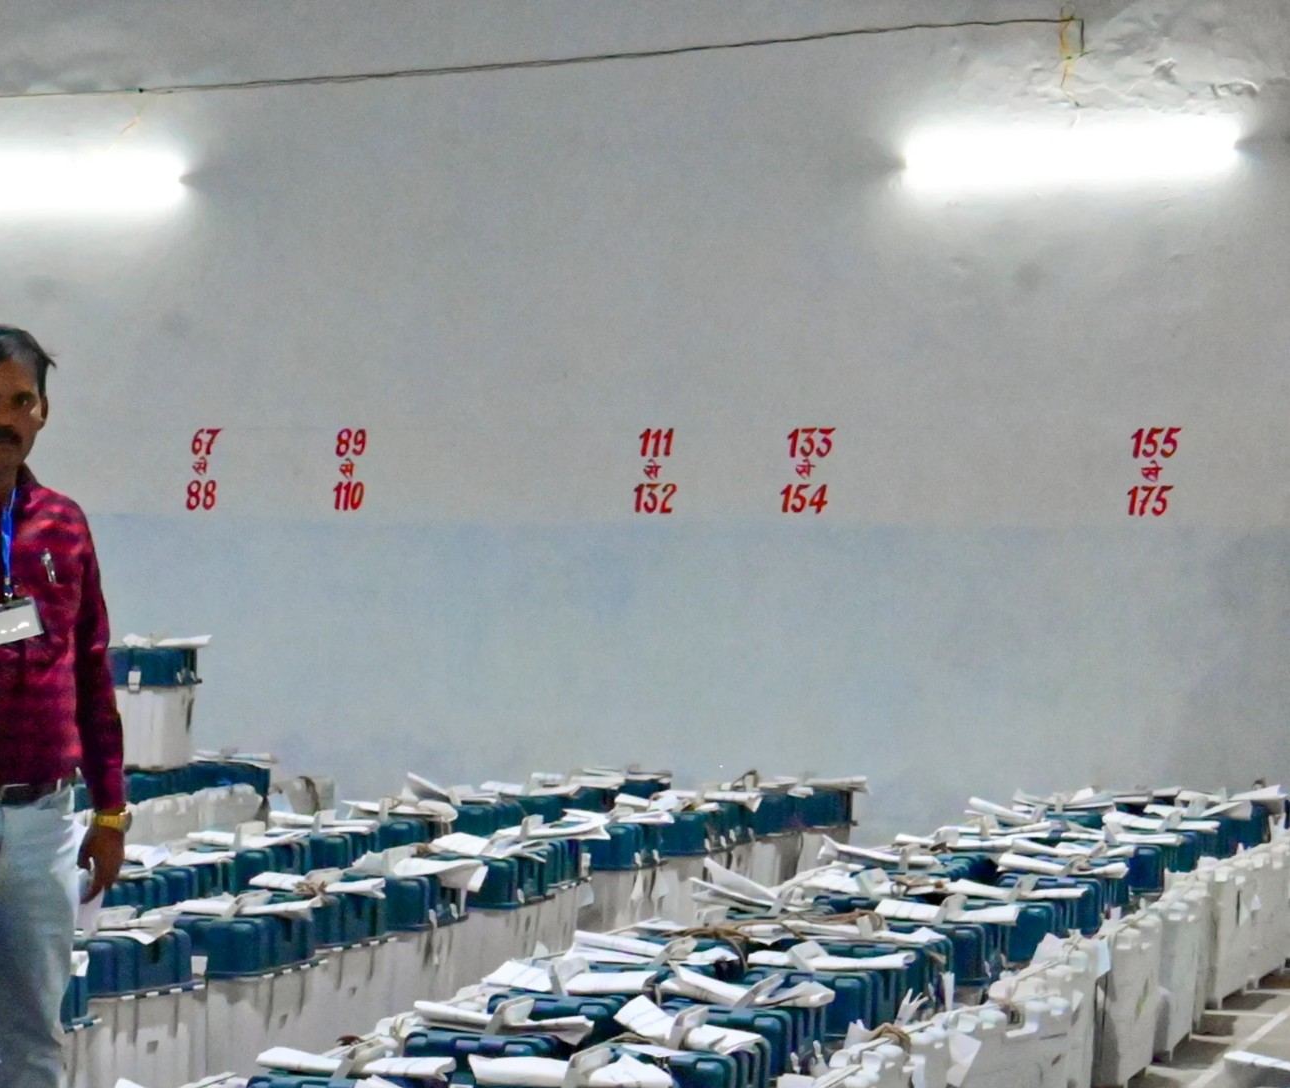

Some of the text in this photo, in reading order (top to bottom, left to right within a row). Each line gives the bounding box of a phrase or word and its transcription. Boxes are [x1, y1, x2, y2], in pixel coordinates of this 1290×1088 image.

[191, 428, 223, 456] 67
[336, 428, 368, 457] 89
[639, 428, 675, 458] 111
[787, 427, 836, 458] 133
[1132, 426, 1183, 459] 155
[186, 480, 217, 511] 88
[333, 482, 365, 511] 110
[634, 482, 678, 514] 132
[780, 484, 829, 514] 154
[1127, 485, 1173, 516] 175
